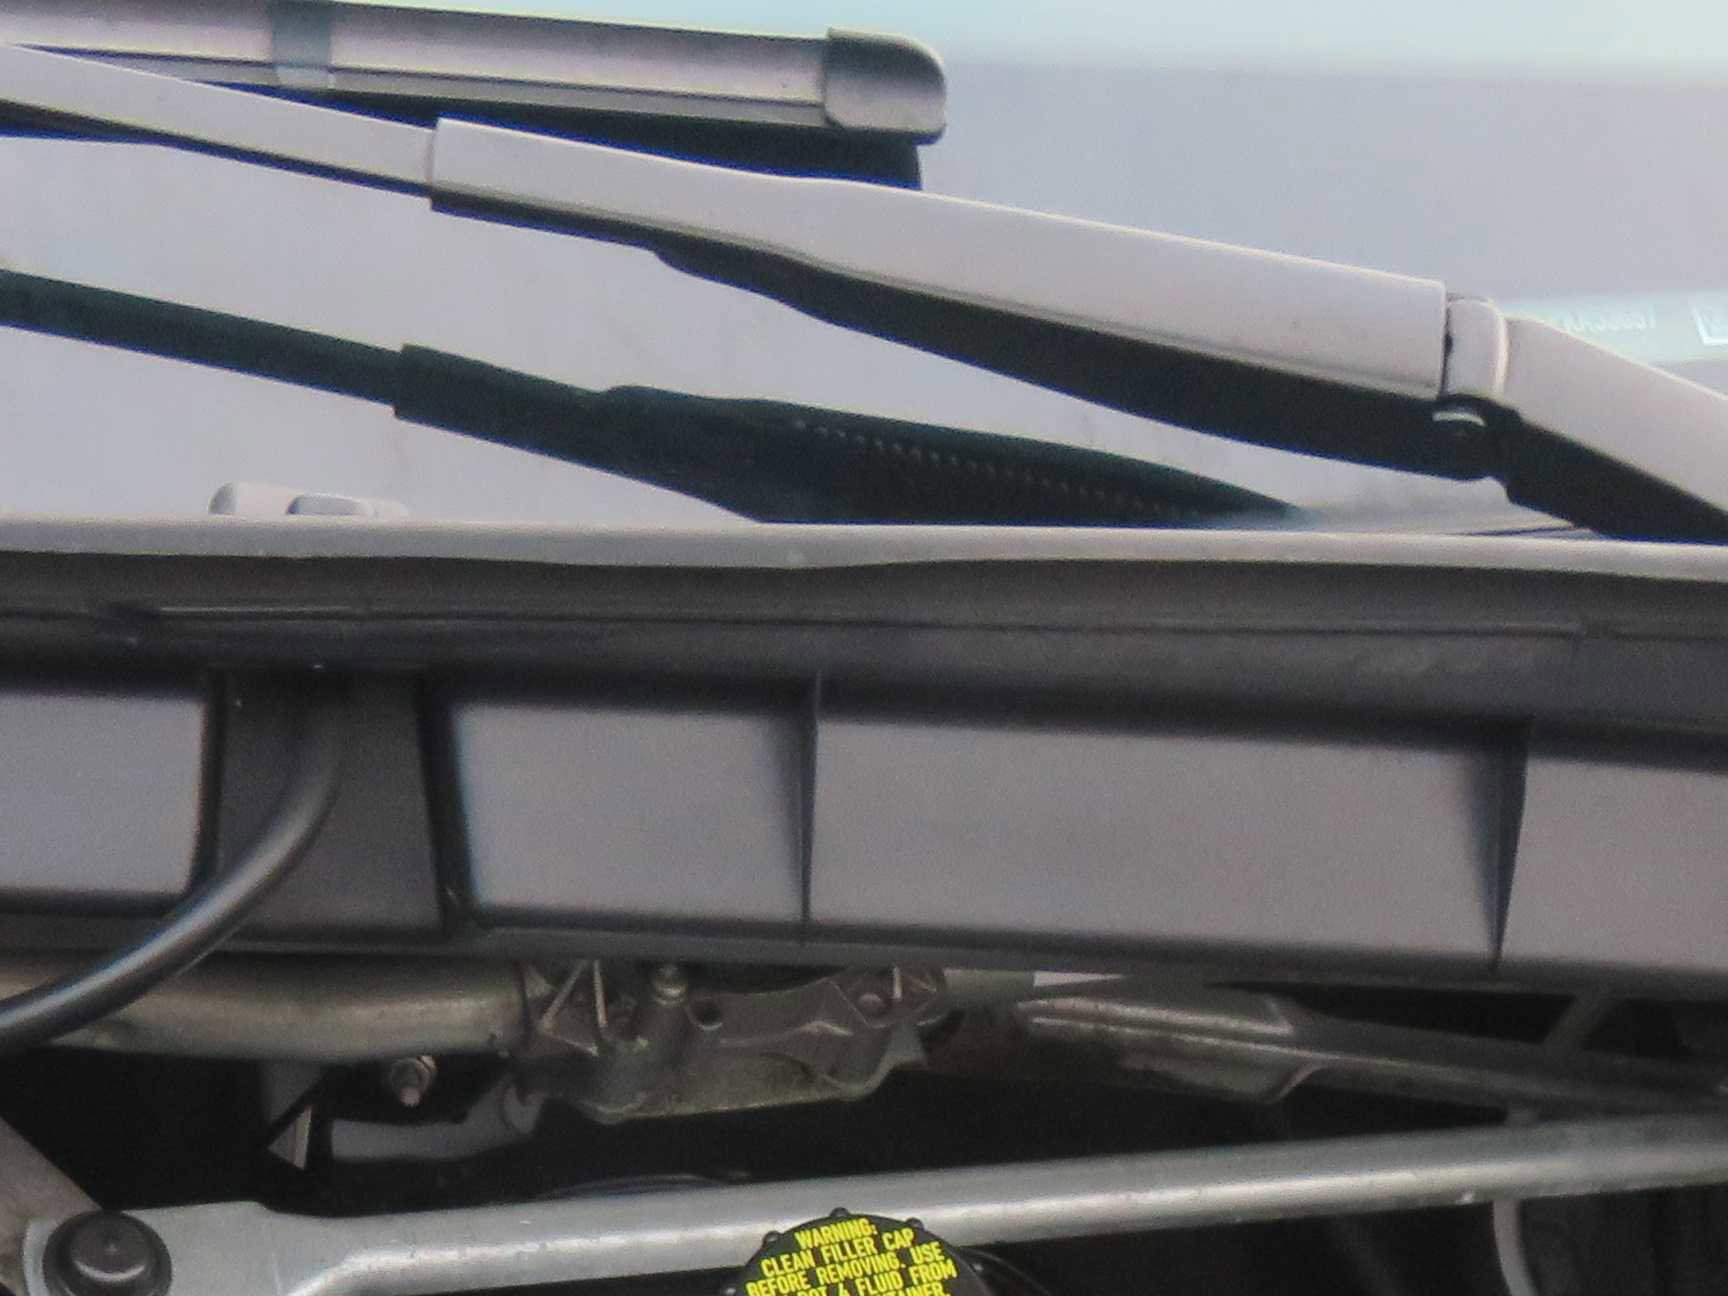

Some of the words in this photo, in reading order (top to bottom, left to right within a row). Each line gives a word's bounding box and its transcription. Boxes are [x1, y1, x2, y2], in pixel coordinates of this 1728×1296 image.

[761, 1250, 816, 1278] CLEAN
[821, 1237, 878, 1265] FILLER
[882, 1228, 914, 1250] CAP
[794, 1218, 878, 1250] WARNING:
[816, 1251, 906, 1285] REMOVING.
[909, 1241, 944, 1265] USE
[909, 1259, 957, 1285] FROM
